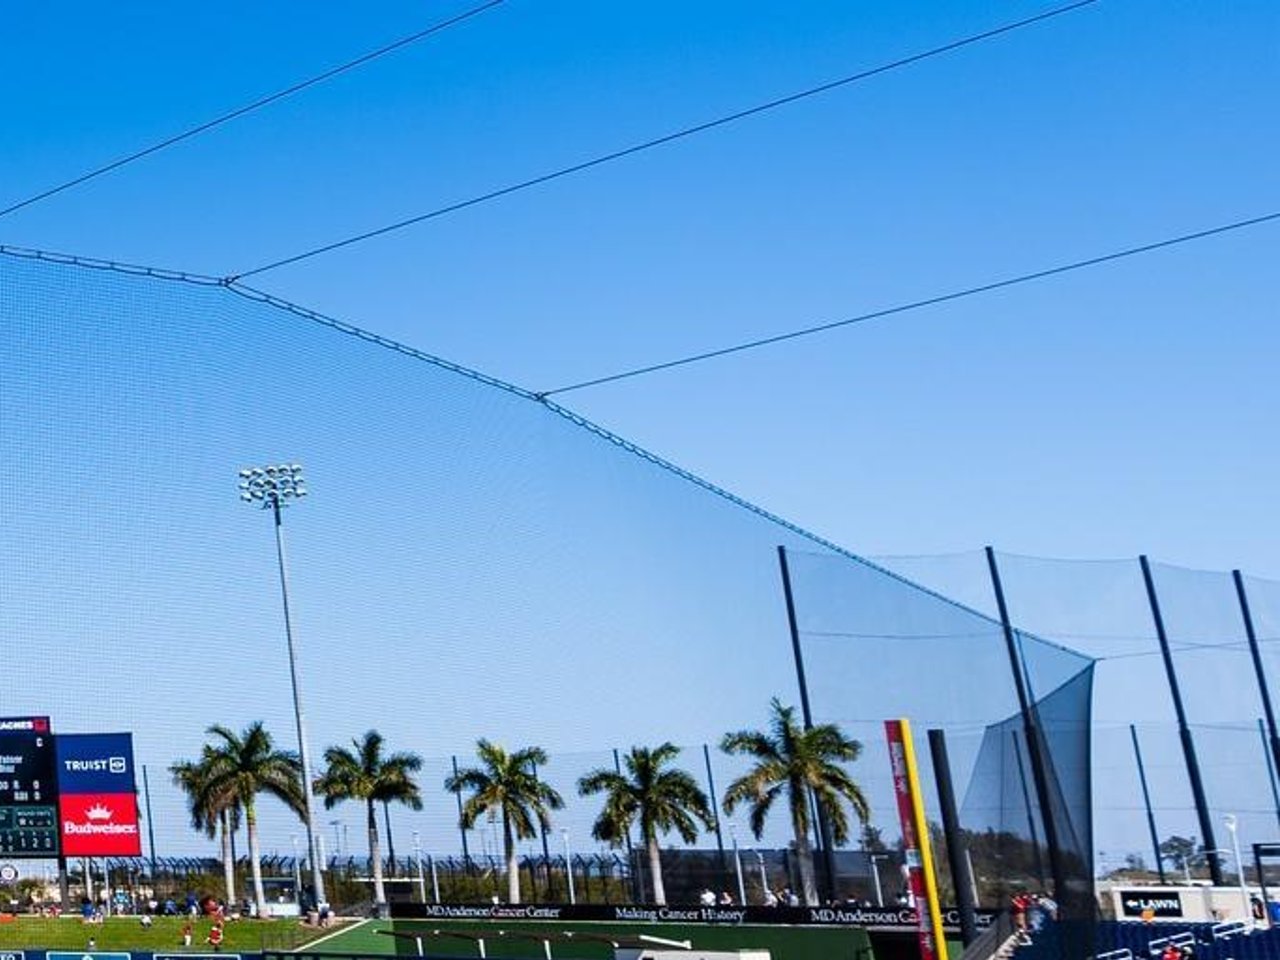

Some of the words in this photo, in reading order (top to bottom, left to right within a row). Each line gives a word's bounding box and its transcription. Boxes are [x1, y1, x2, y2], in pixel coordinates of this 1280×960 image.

[64, 761, 107, 771] TRUIST
[64, 821, 137, 834] Budweiser
[1140, 899, 1180, 909] LAWN
[426, 905, 444, 916] MD
[444, 905, 489, 917] Anderson
[491, 906, 526, 918] Cancer
[527, 907, 561, 918] Center
[616, 907, 658, 920] Making
[660, 908, 700, 920] Cancer
[702, 909, 745, 921] History
[811, 910, 834, 921] MD
[836, 910, 897, 923] Anderson
